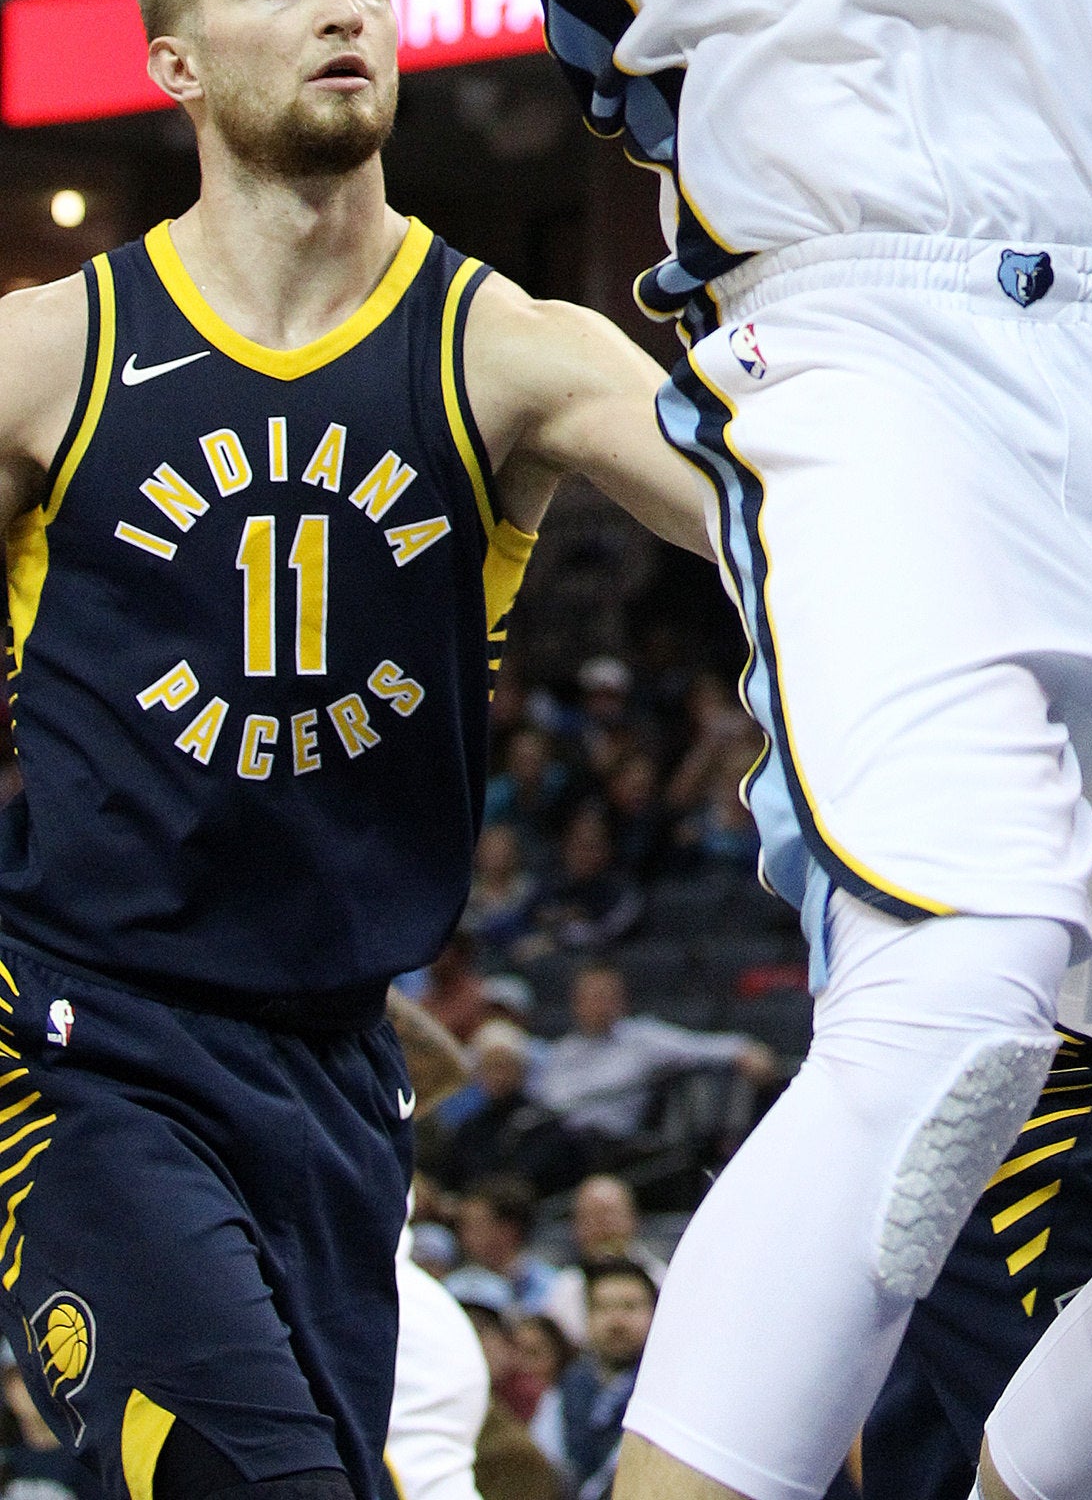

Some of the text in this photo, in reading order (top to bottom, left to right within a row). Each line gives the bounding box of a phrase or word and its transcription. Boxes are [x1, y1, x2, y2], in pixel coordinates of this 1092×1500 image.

[114, 416, 452, 567] INDIANA
[235, 514, 329, 676] 11
[136, 659, 426, 781] PACERS
